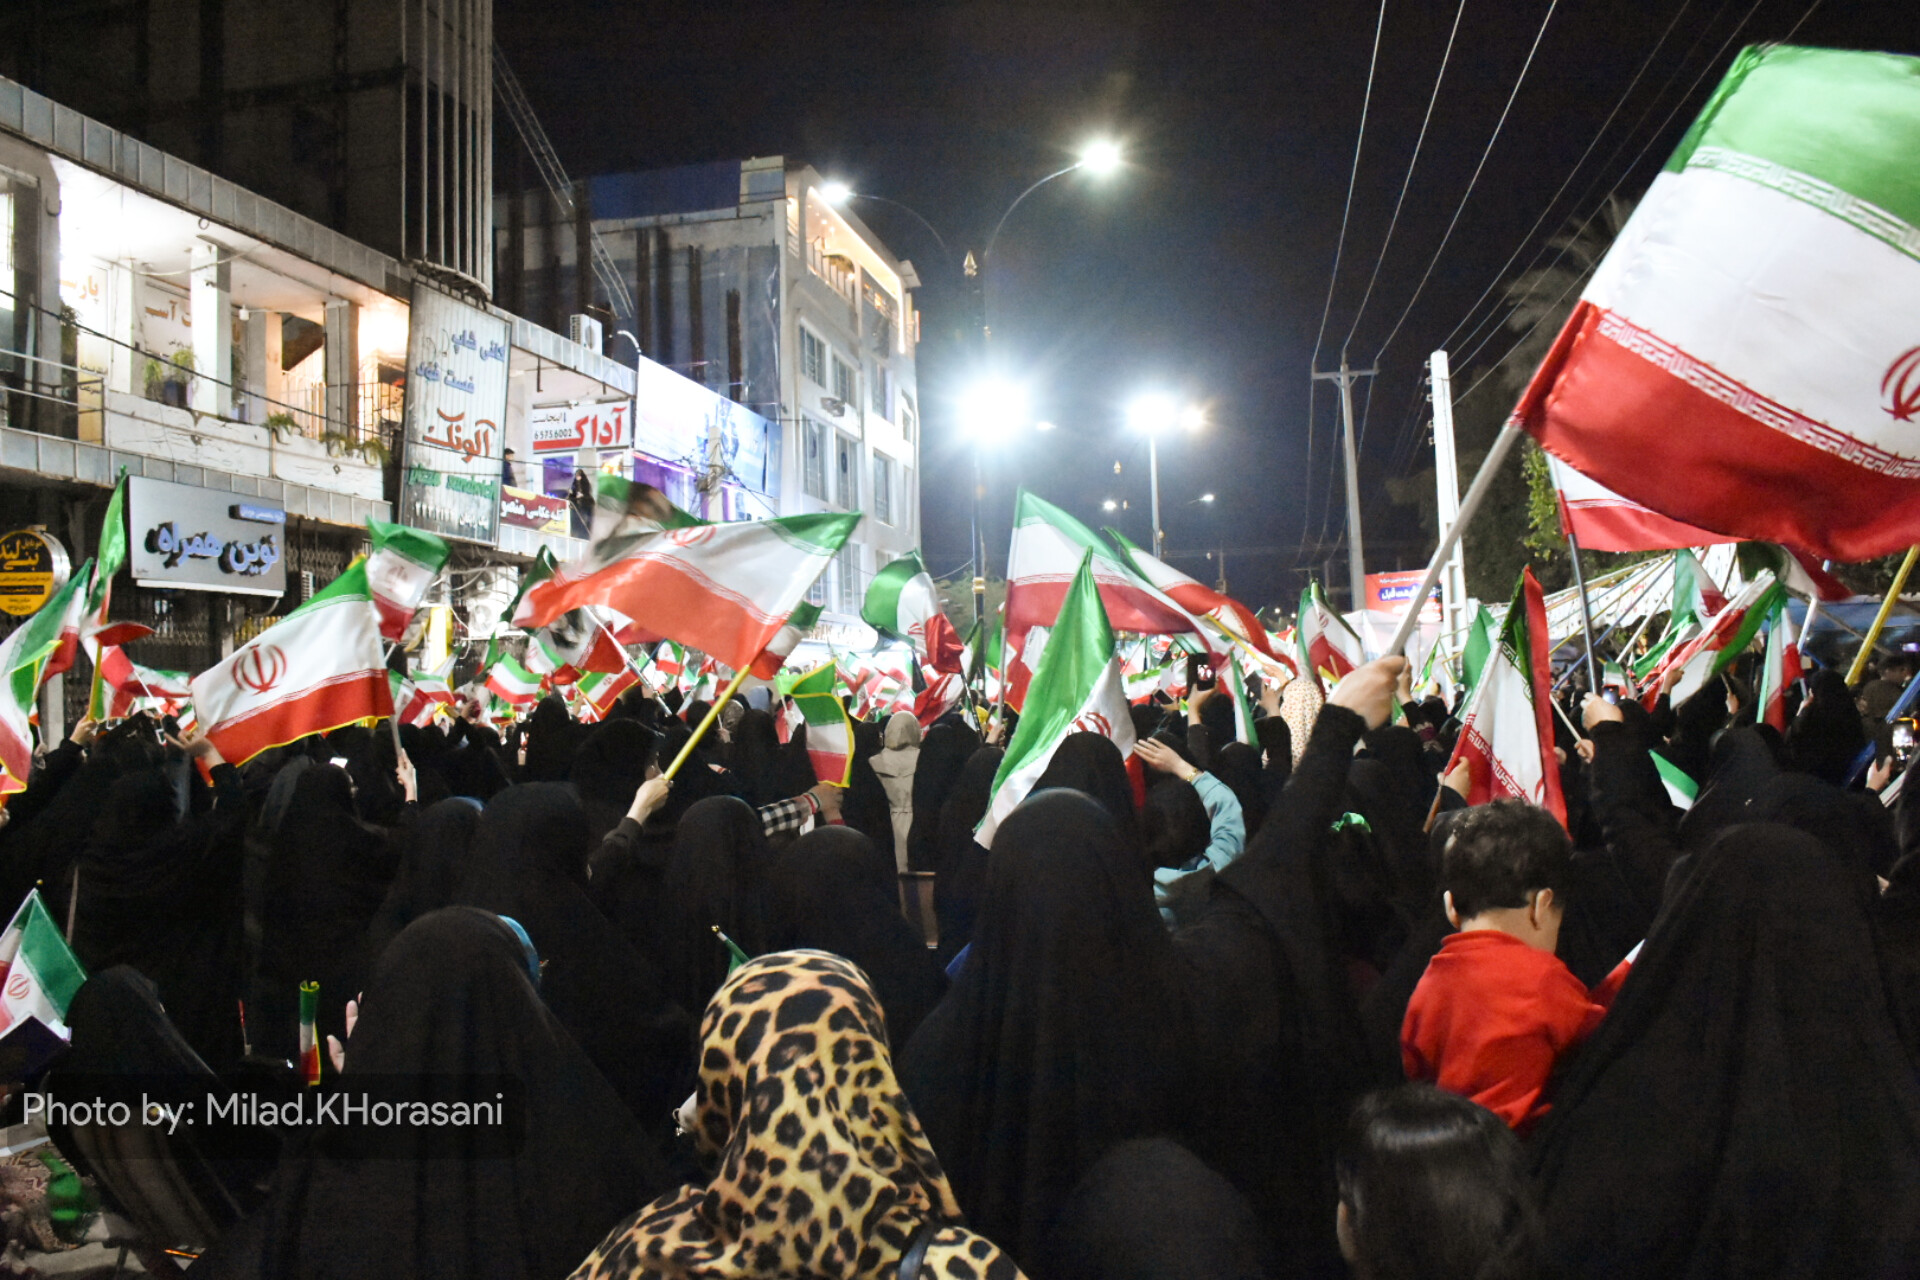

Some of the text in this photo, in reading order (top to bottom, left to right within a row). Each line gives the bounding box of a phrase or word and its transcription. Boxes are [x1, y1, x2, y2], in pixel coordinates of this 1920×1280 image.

[451, 329, 477, 355] شاپ
[533, 406, 628, 450] آداک
[158, 521, 280, 576] نوین همراه
